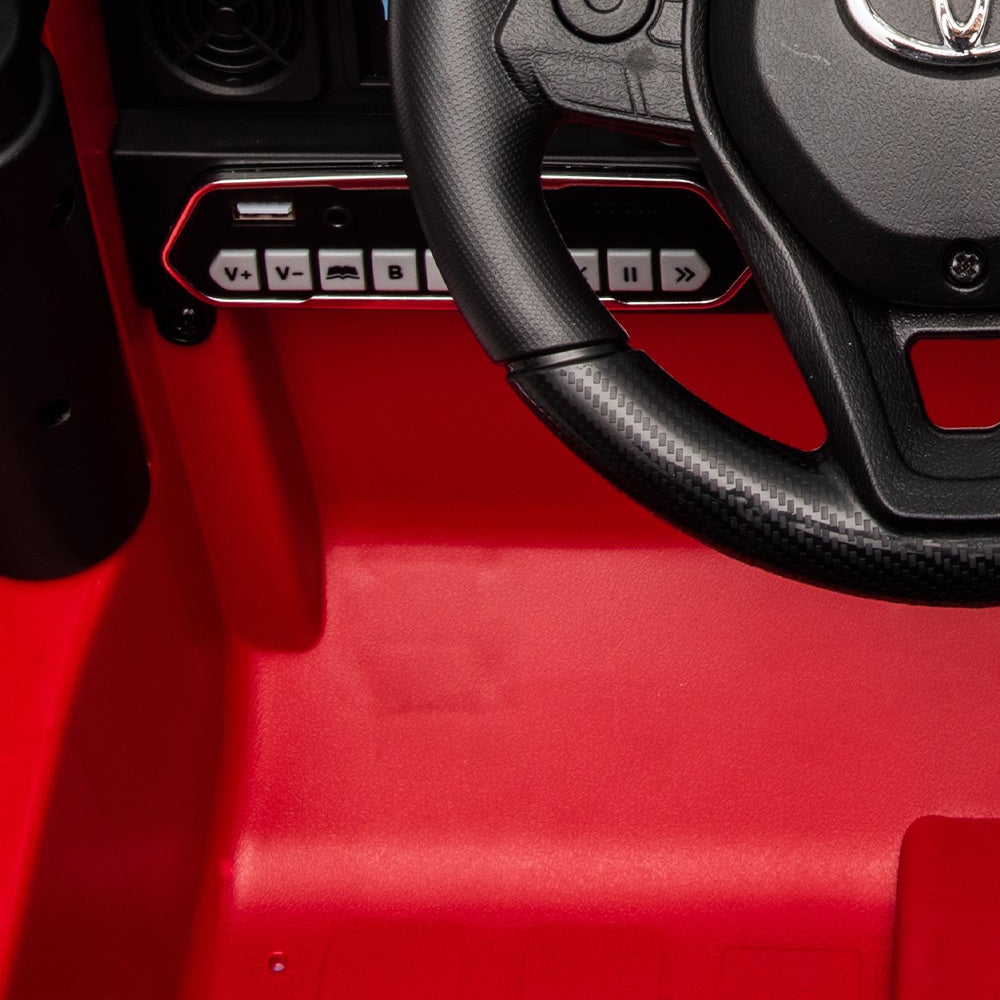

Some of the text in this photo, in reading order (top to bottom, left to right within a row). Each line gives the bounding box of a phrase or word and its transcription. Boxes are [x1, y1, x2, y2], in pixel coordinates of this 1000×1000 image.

[224, 266, 253, 281] V+
[275, 266, 304, 281] V-
[388, 265, 404, 281] B
